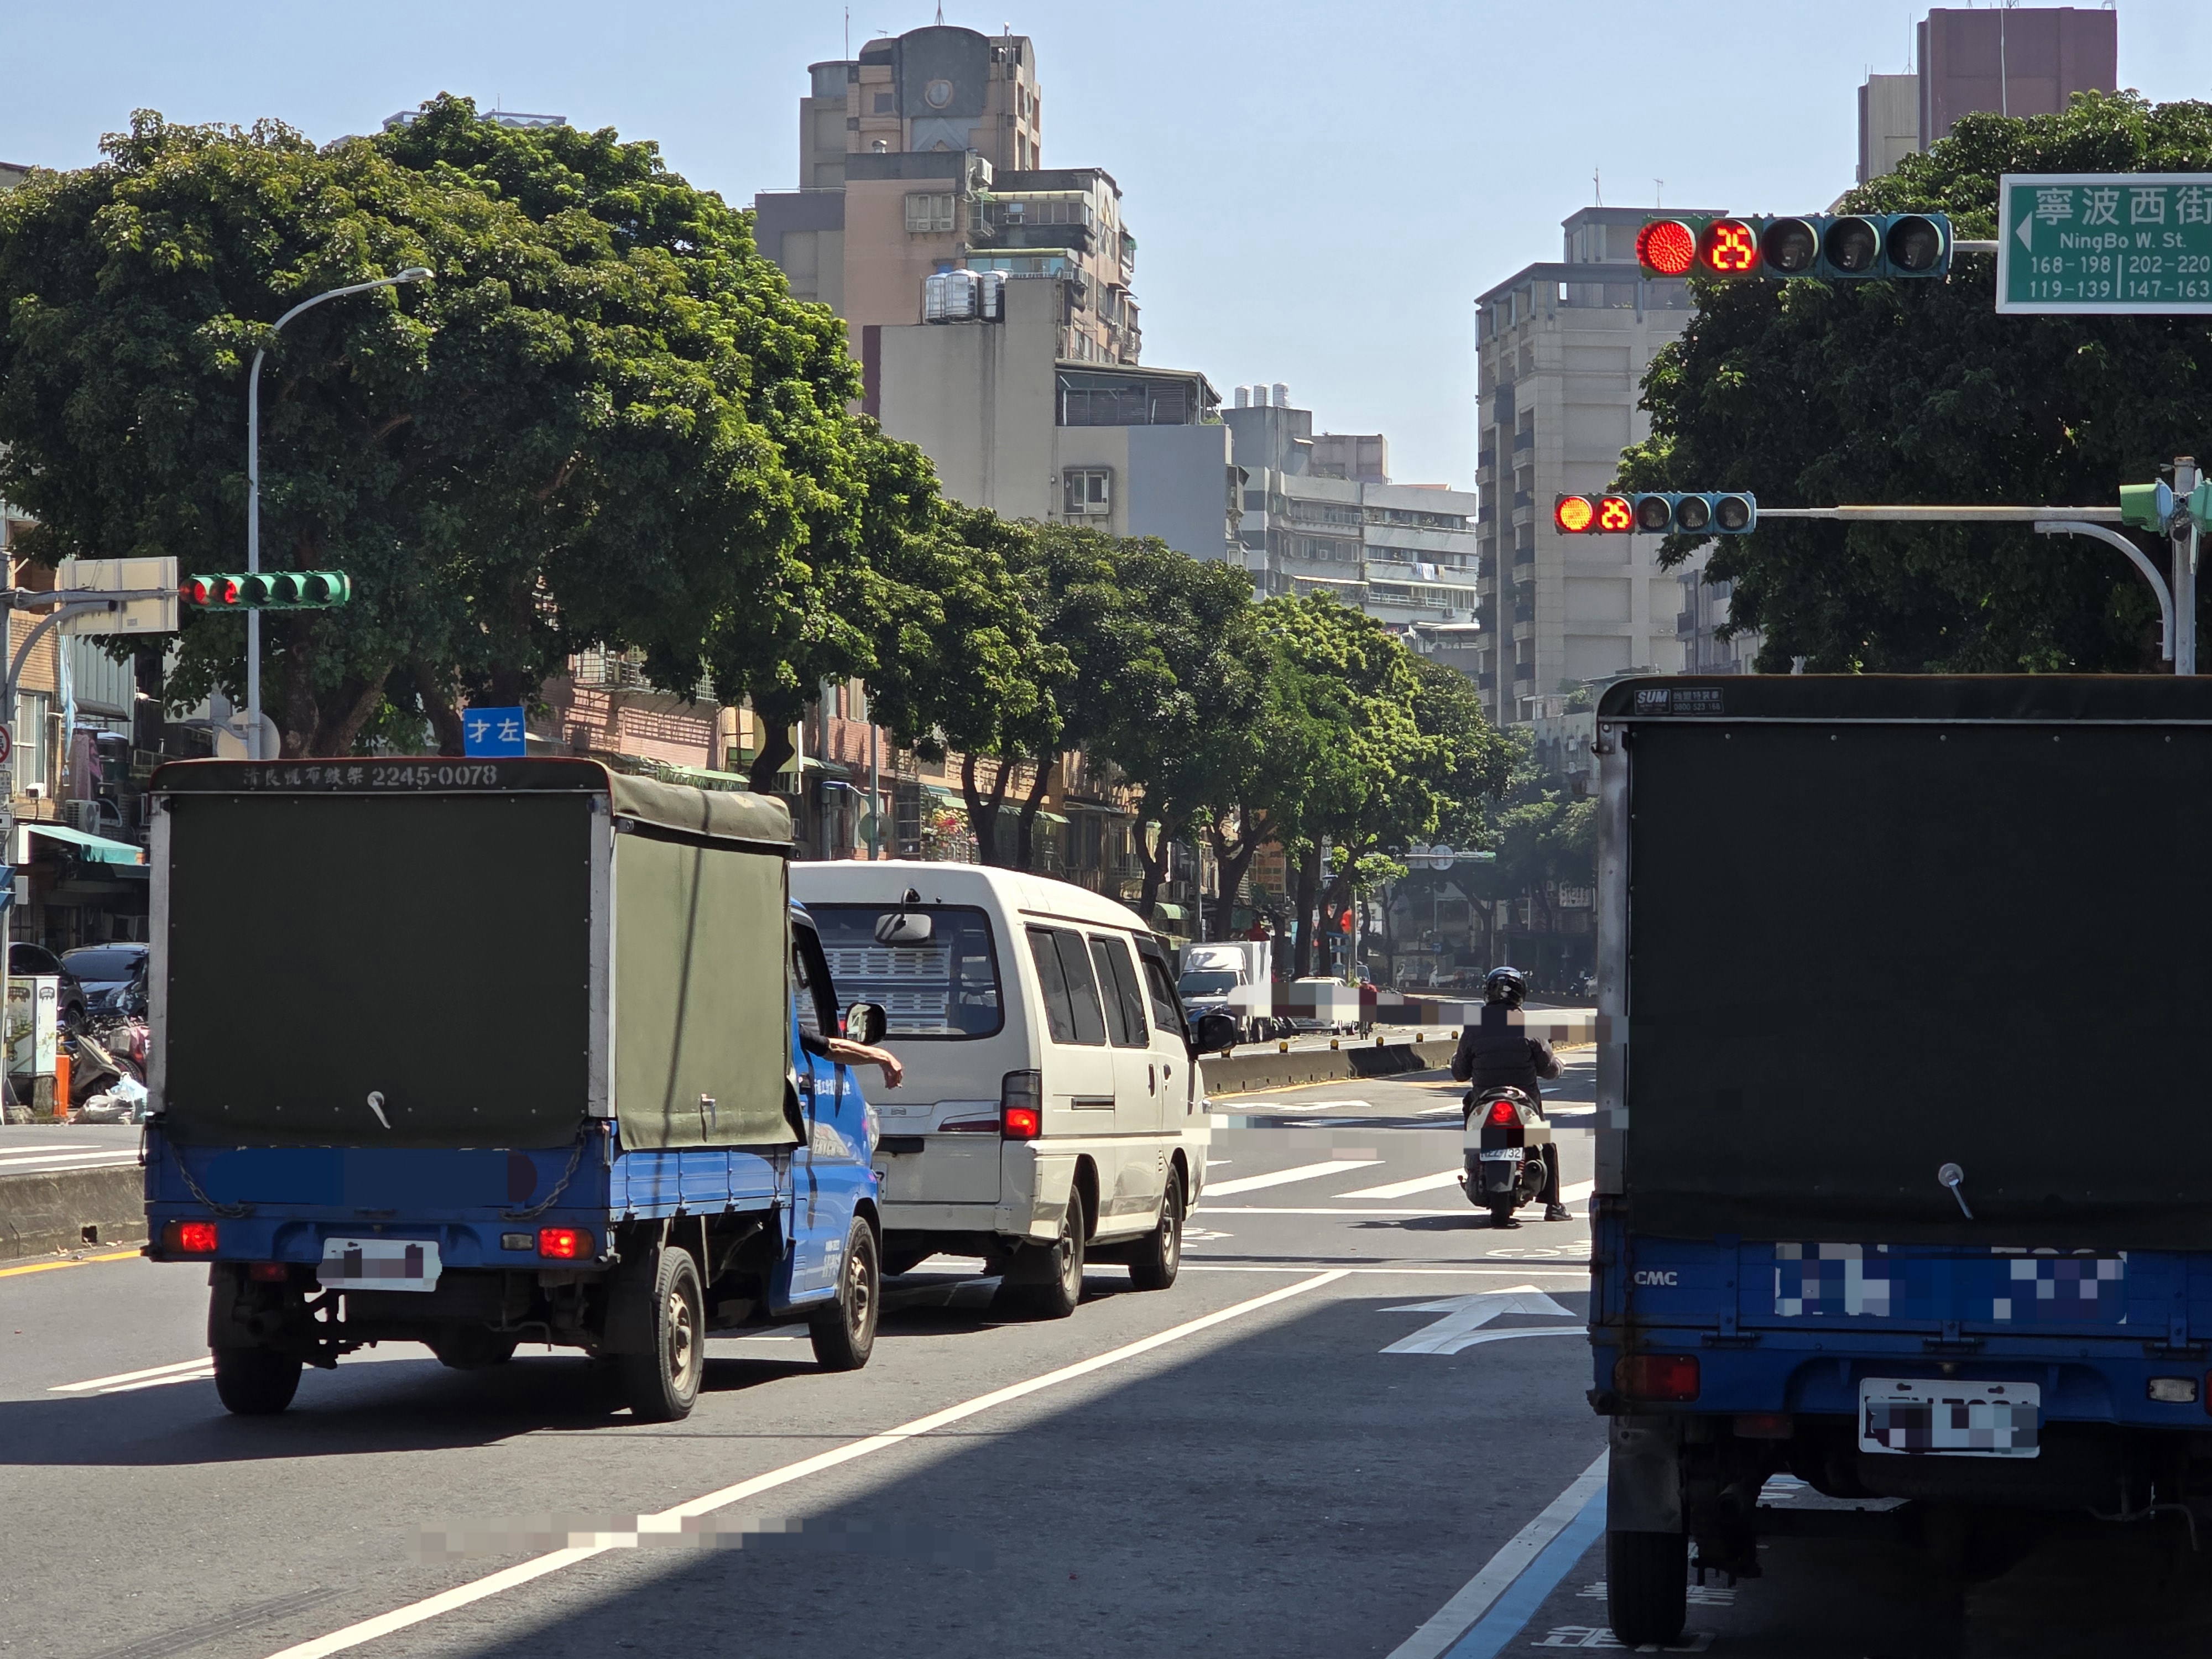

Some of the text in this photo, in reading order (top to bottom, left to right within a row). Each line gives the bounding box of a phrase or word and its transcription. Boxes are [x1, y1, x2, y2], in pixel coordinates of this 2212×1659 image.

[2035, 186, 2212, 225] 寧波西街
[1713, 227, 1751, 269] 25
[2060, 232, 2187, 253] NingBo W. St.
[2031, 256, 2111, 273] 168-198
[2129, 255, 2211, 273] 202-220
[2030, 280, 2110, 298] 119-139
[2129, 280, 2210, 298] 147-163
[1601, 500, 1628, 529] 25
[1637, 691, 1668, 703] SUM
[372, 765, 497, 786] 2245-0078
[1634, 1271, 1678, 1286] CMC
